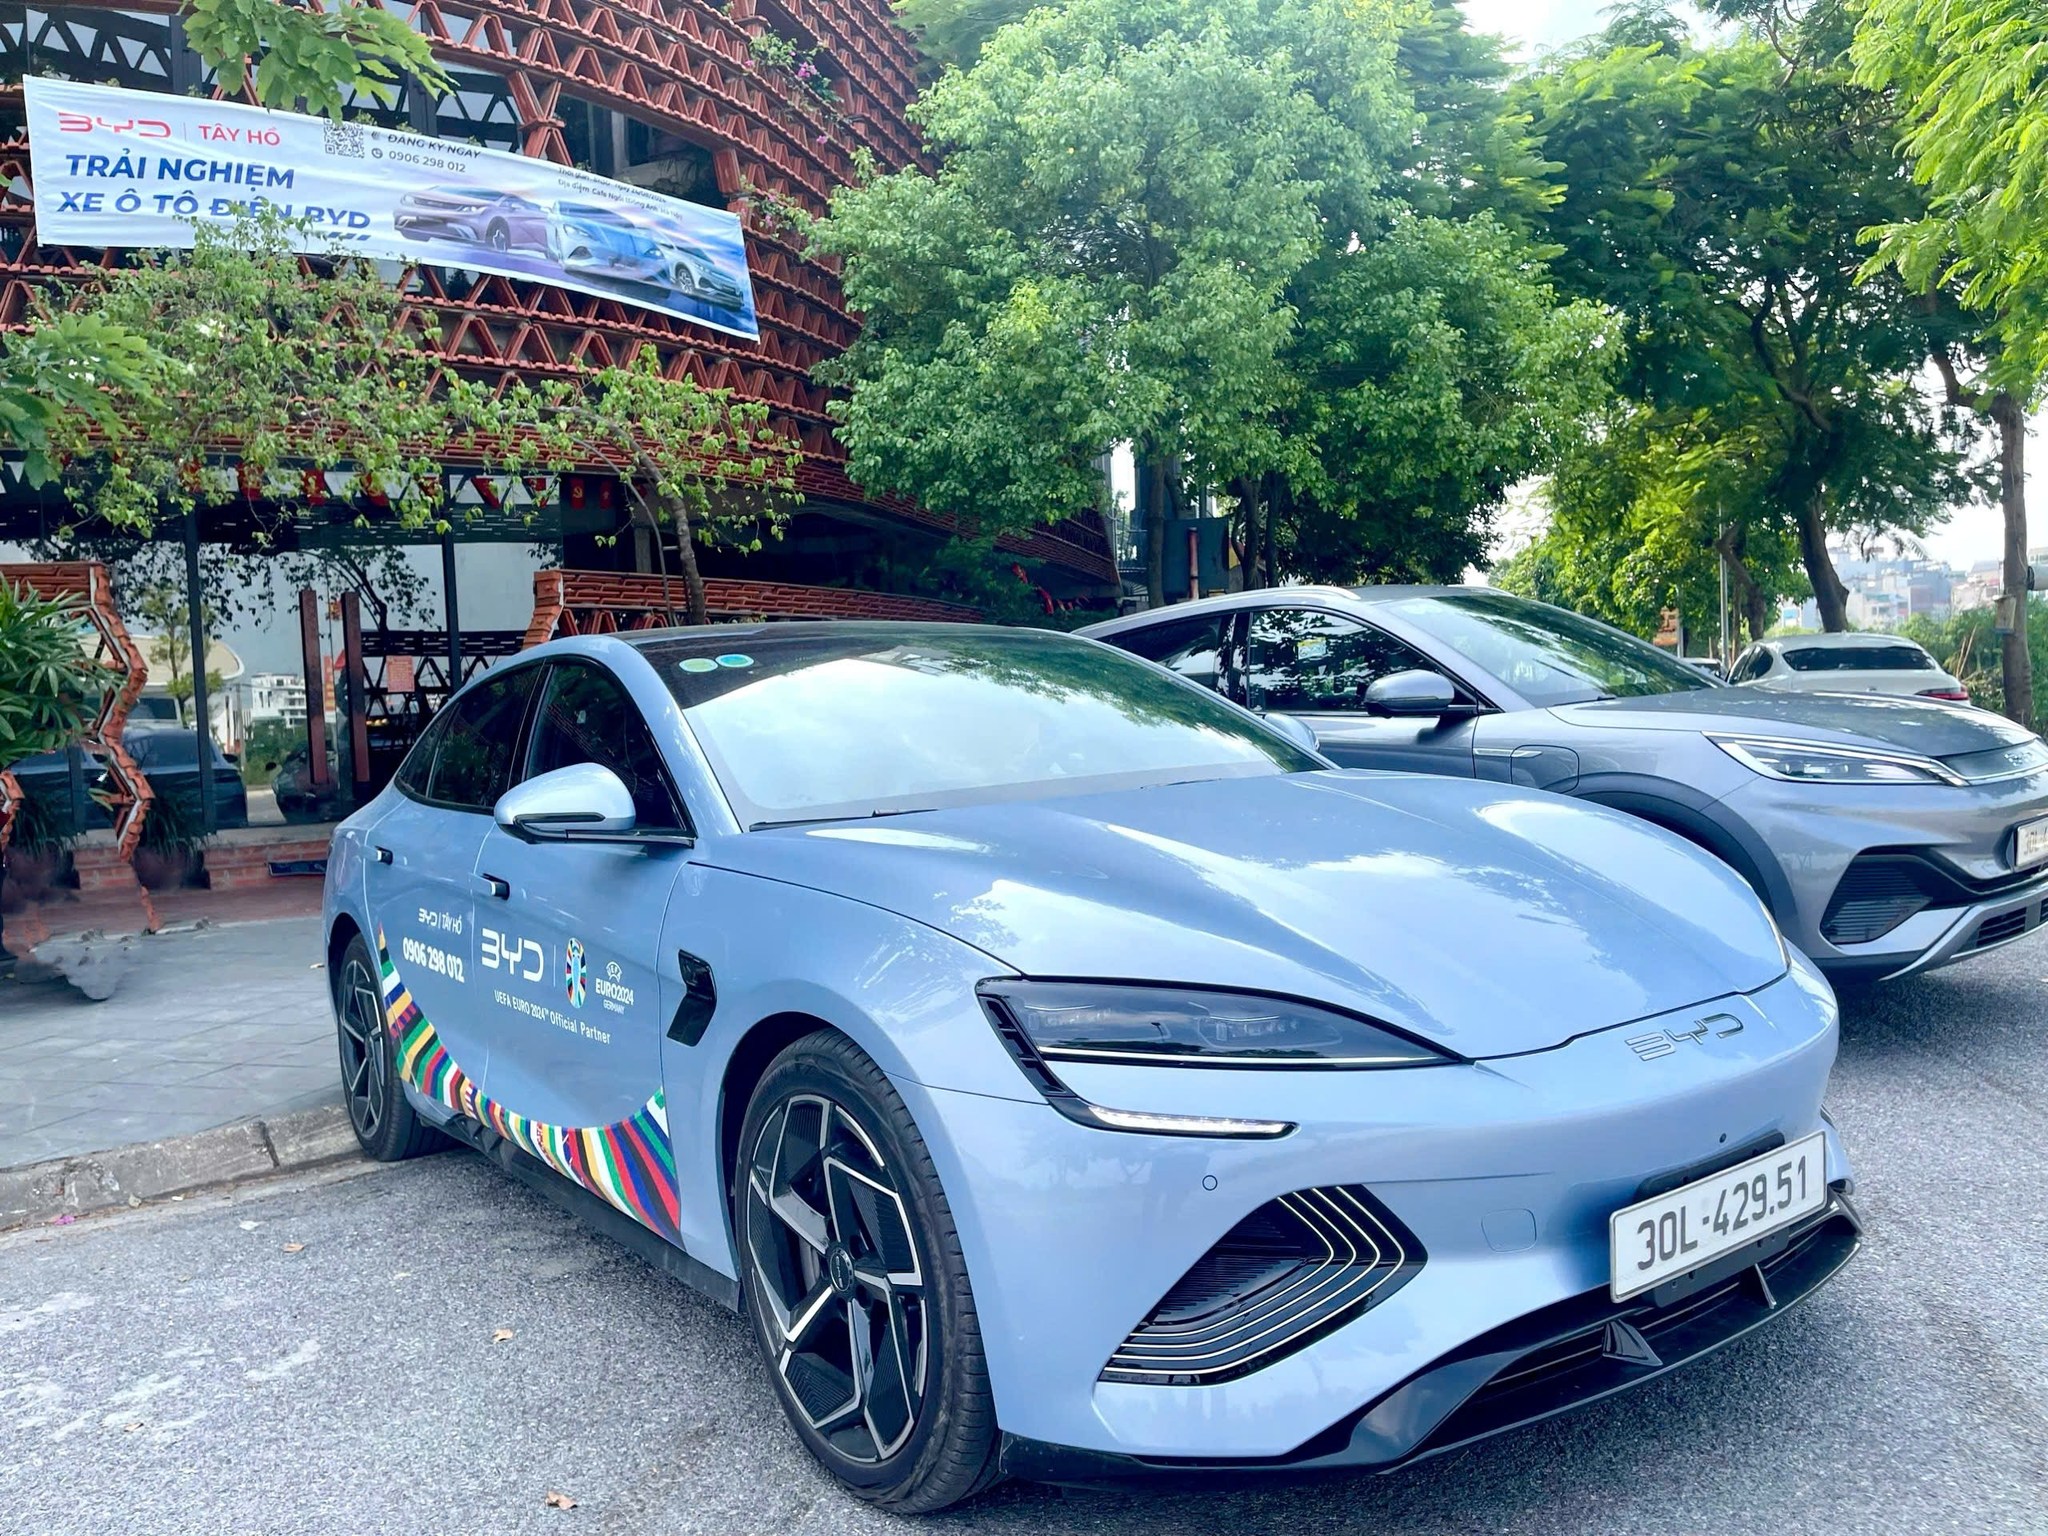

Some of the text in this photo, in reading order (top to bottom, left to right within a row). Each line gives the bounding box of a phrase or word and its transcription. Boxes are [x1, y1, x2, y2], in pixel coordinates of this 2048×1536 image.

[58, 112, 280, 146] BYD TÂY HỒ
[66, 147, 295, 192] TRẢI NGHIỆM
[389, 150, 466, 173] 0906 298 012
[446, 146, 482, 159] NGAY
[57, 191, 105, 213] XE
[115, 188, 142, 213] Ô
[153, 189, 199, 214] TÔ
[304, 205, 371, 229] BYD
[418, 907, 438, 927] BYD
[402, 936, 465, 984] 0906 298 012
[481, 928, 544, 983] BYD
[493, 989, 512, 1008] UEFA
[511, 996, 531, 1015] EURO
[549, 1010, 578, 1034] Official
[579, 1021, 611, 1045] Partner
[1625, 1013, 1744, 1061] BYD
[1636, 1155, 1807, 1271] 30L-429.51
